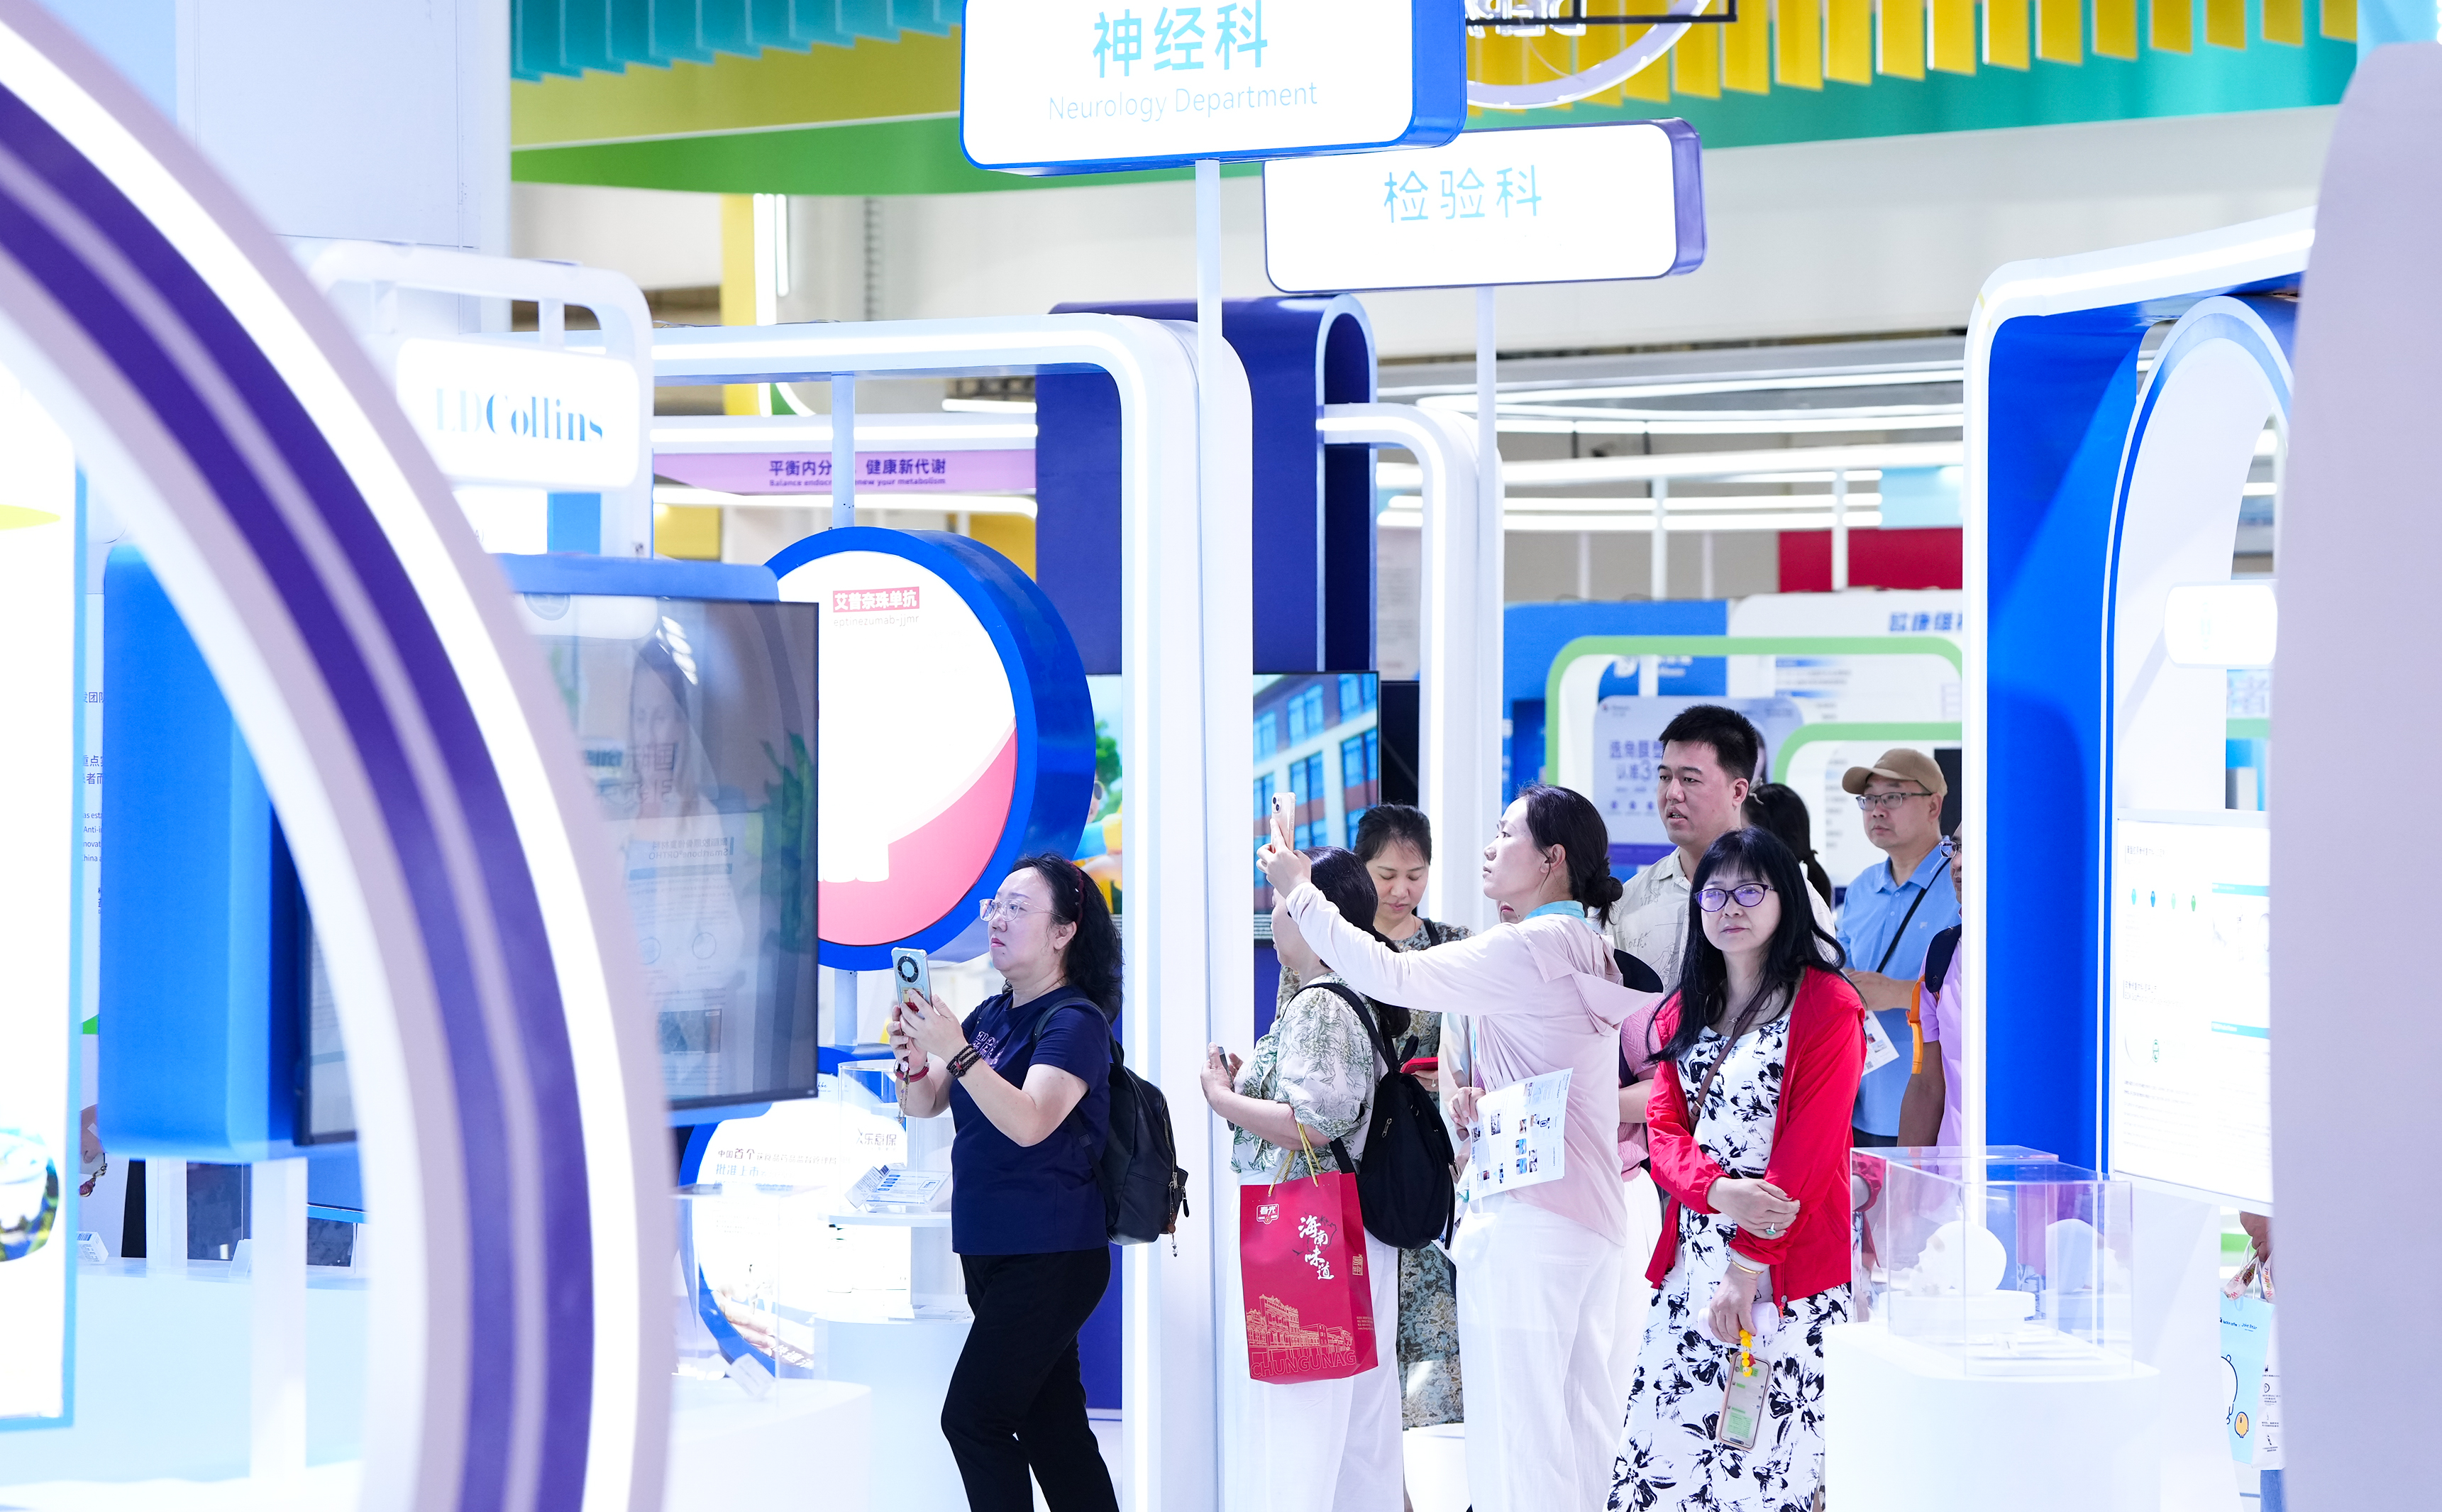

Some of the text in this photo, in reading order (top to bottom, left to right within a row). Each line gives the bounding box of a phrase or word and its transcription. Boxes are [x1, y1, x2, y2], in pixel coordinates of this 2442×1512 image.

[1093, 0, 1268, 78] 神经科
[1049, 82, 1317, 122] Neurology Department
[1384, 164, 1542, 223] 检验科
[866, 458, 946, 475] 健康新代谢
[834, 589, 917, 611] 艾普奈珠单抗
[1298, 1214, 1335, 1281] 海南味道
[1250, 1349, 1357, 1378] CHUNGUNAG
